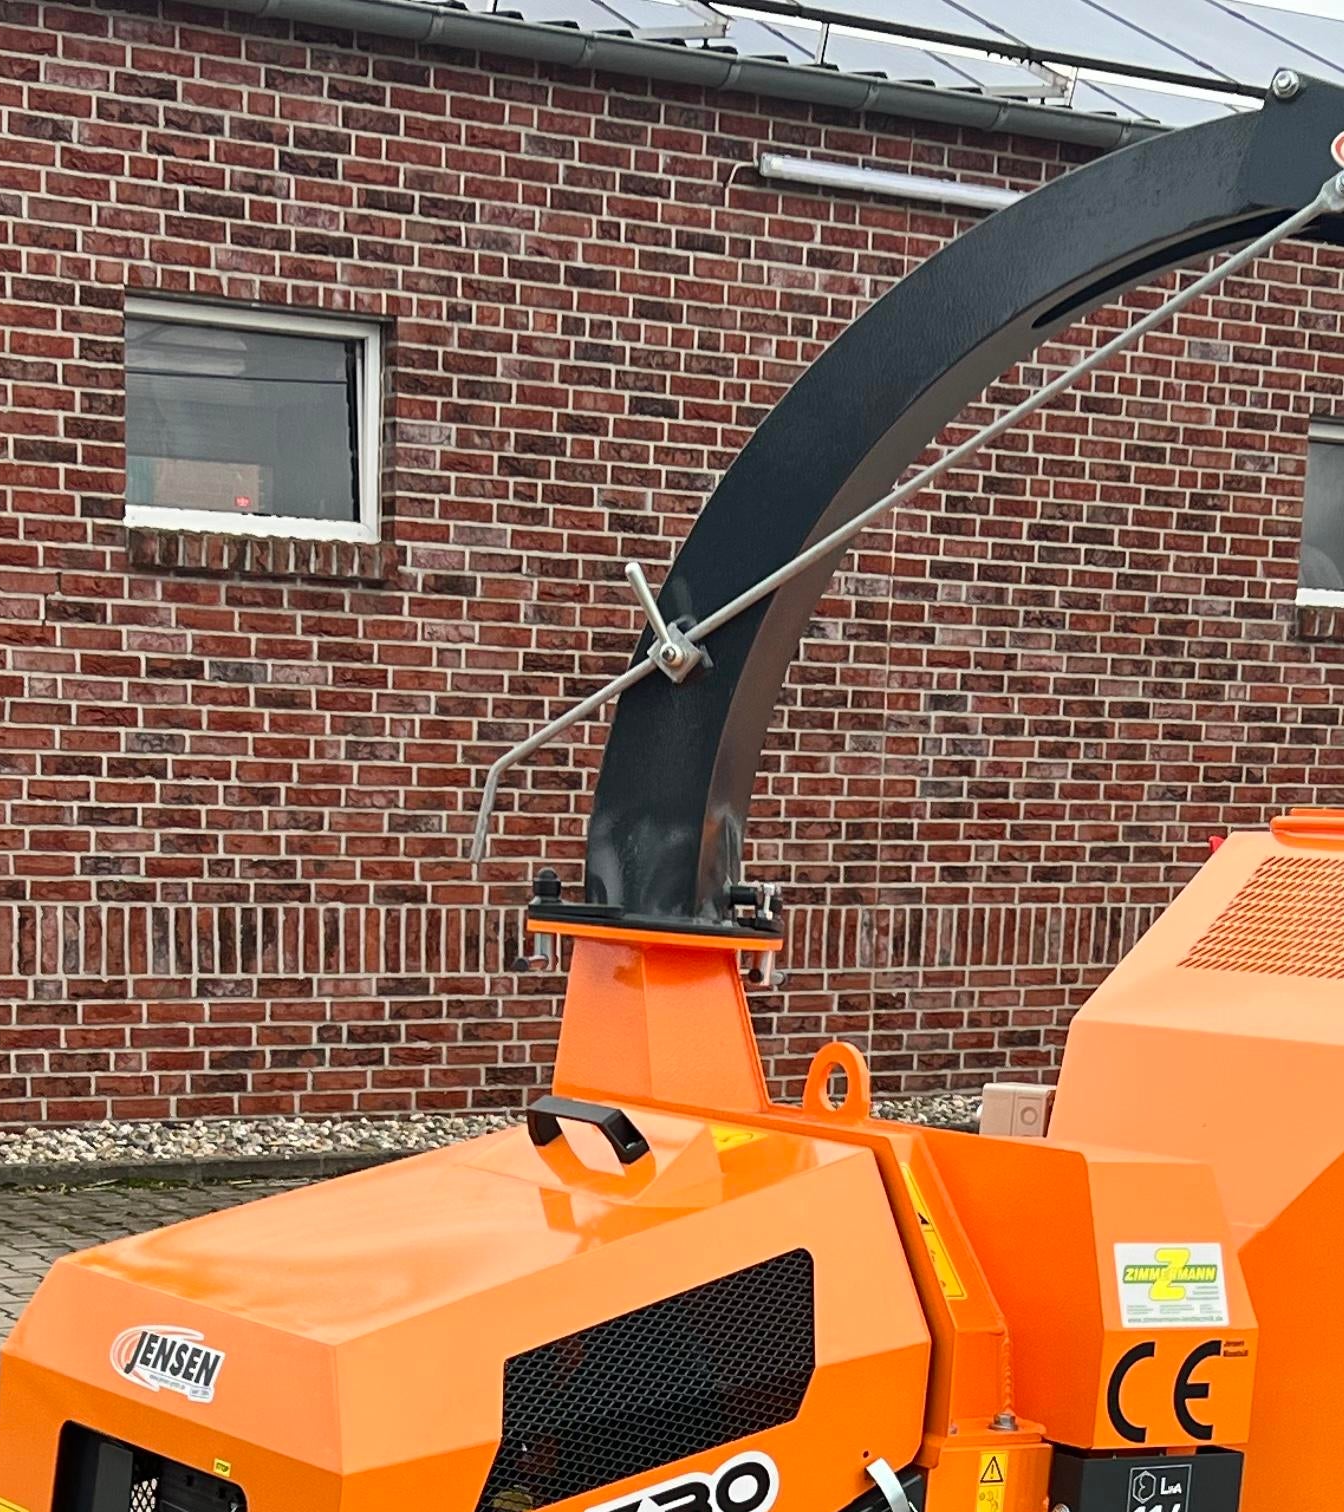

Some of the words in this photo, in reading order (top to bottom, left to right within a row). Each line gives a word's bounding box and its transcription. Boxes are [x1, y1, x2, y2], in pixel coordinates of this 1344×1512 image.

[1124, 1266, 1217, 1283] ZIMMERMANN
[125, 1331, 220, 1386] JENSEN
[1107, 1340, 1222, 1443] CE
